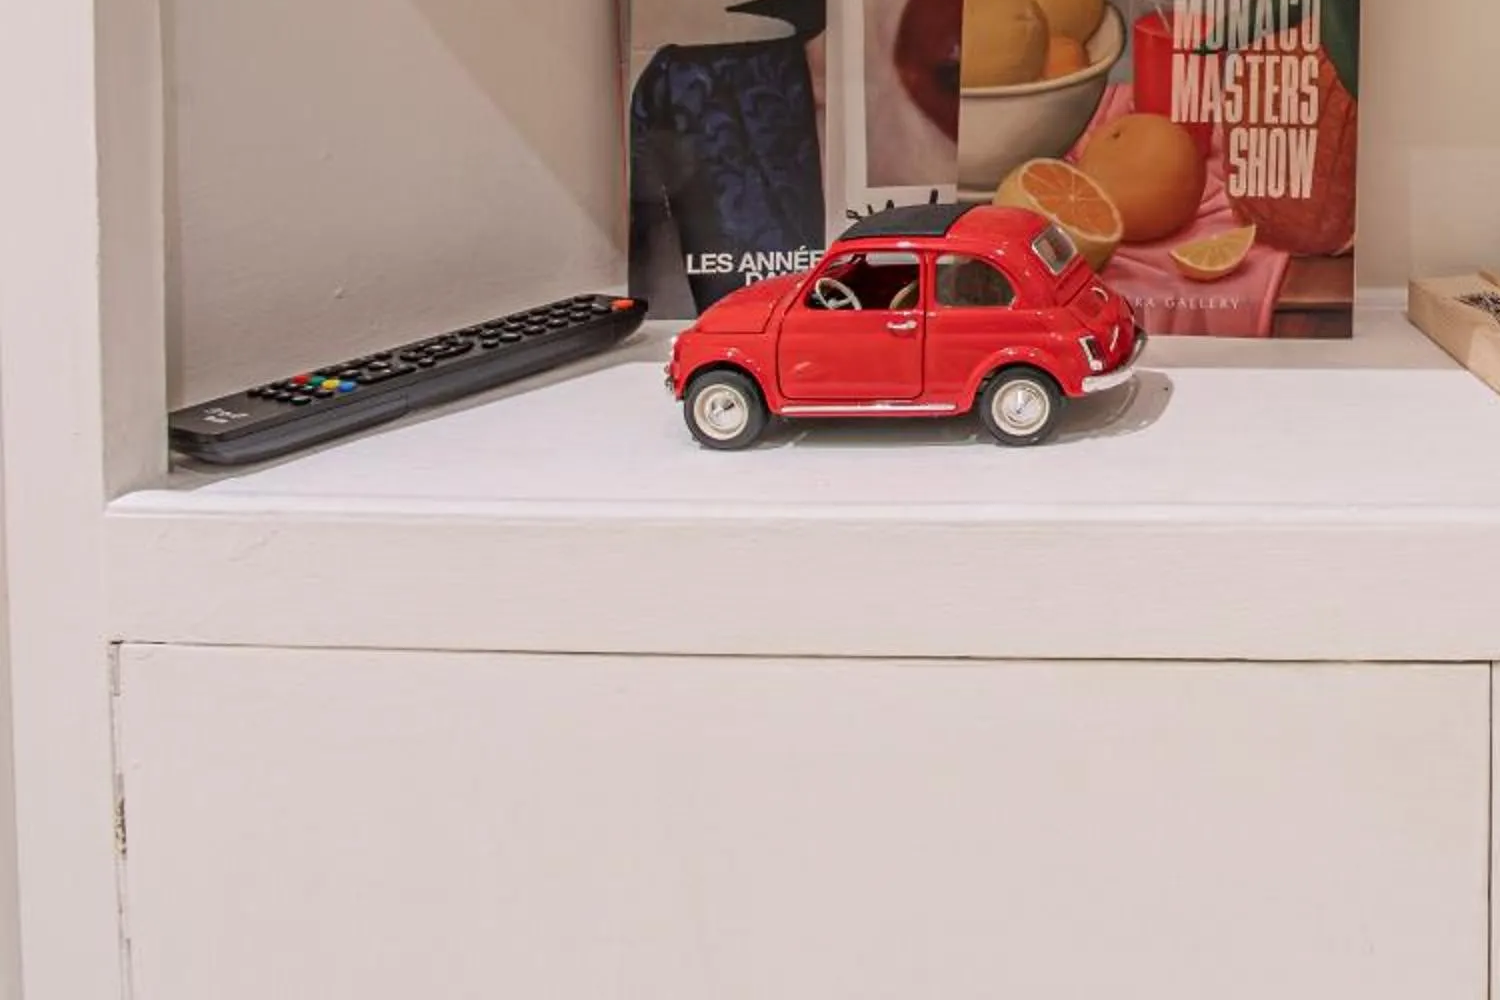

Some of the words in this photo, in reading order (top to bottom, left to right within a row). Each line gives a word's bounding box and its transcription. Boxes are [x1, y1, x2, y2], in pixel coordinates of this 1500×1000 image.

[1170, 54, 1319, 125] MASTERS
[1228, 127, 1318, 200] SHOW
[686, 253, 733, 275] LES
[737, 245, 825, 273] ANNÉE
[1165, 297, 1240, 309] GALLERY
